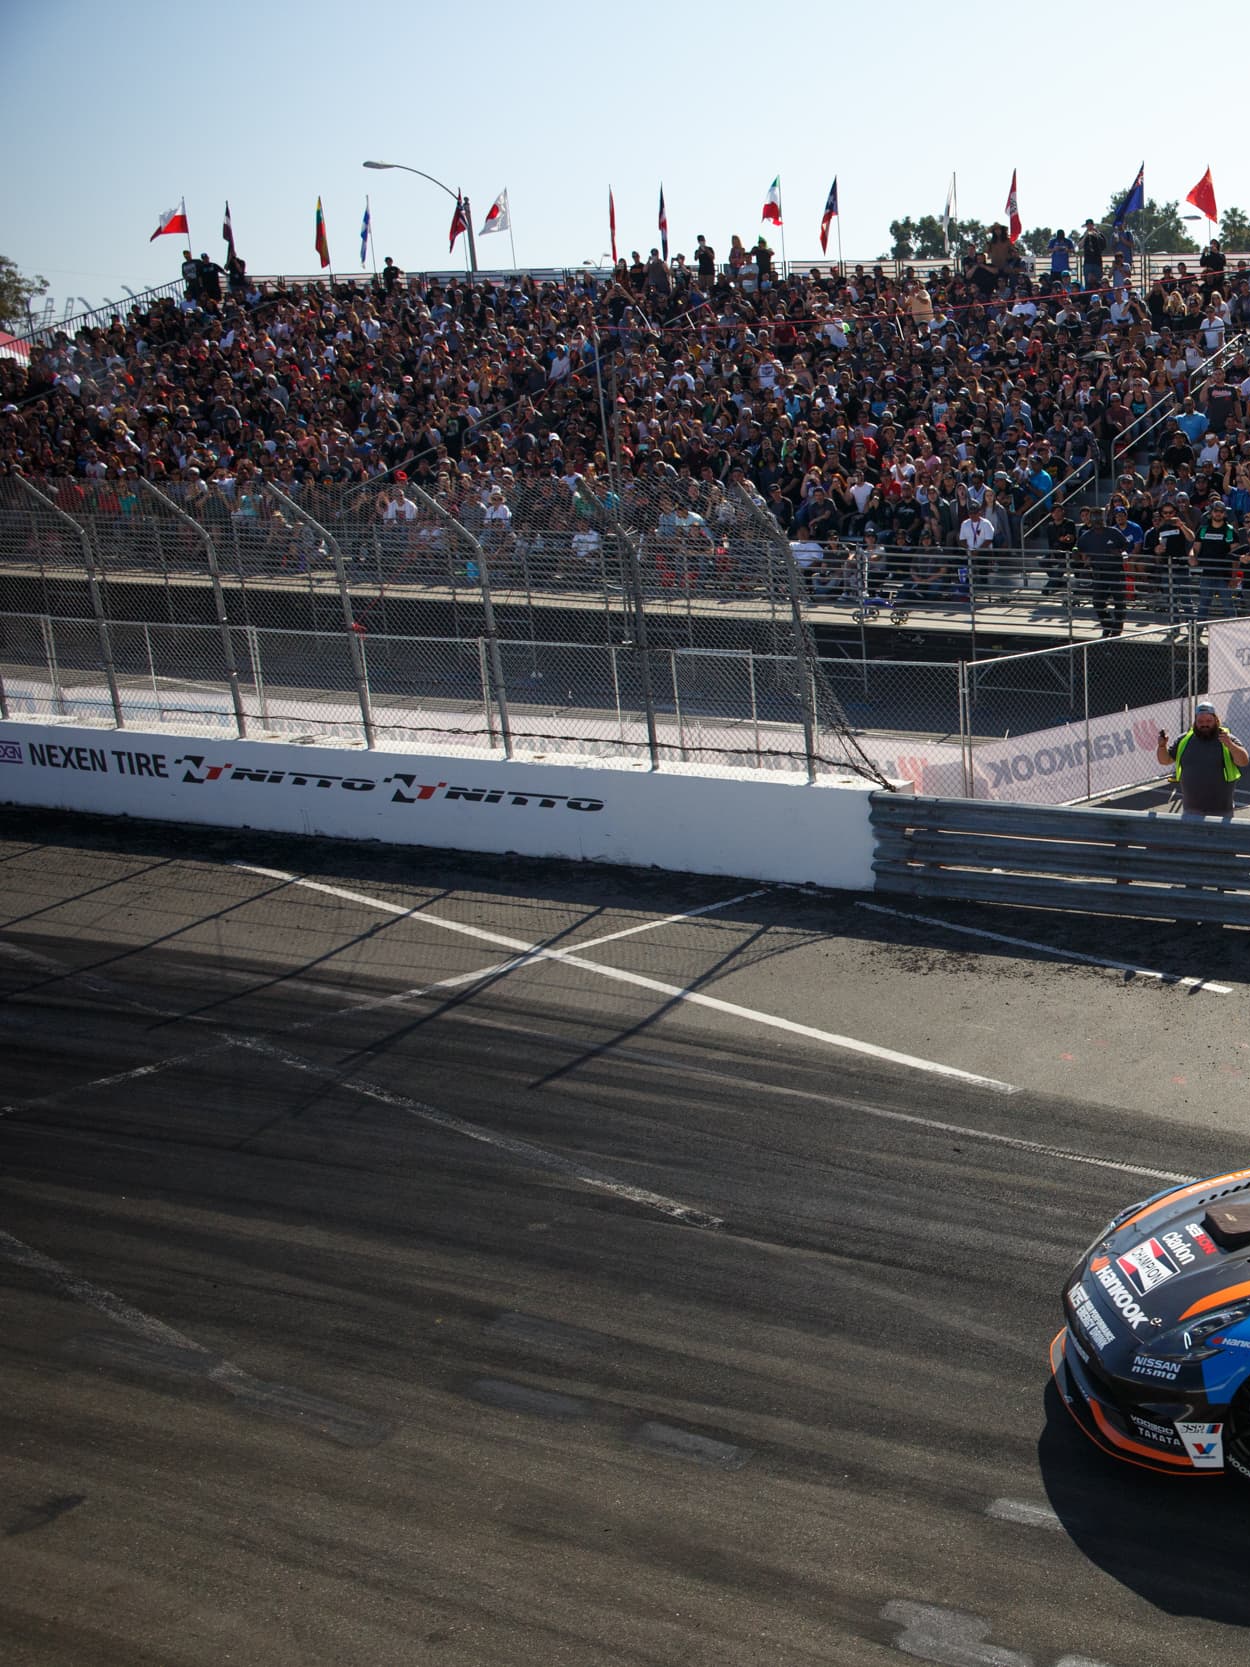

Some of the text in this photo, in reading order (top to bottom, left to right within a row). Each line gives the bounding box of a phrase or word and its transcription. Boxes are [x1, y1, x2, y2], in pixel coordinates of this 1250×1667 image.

[28, 743, 169, 779] NEXEN TIRE
[230, 767, 377, 792] NITTO
[445, 786, 605, 812] NITTO
[1131, 1248, 1165, 1285] CHAMPION
[1131, 1366, 1177, 1380] nismo
[1133, 1356, 1181, 1373] NISSAN
[1138, 1427, 1181, 1446] TAKATA
